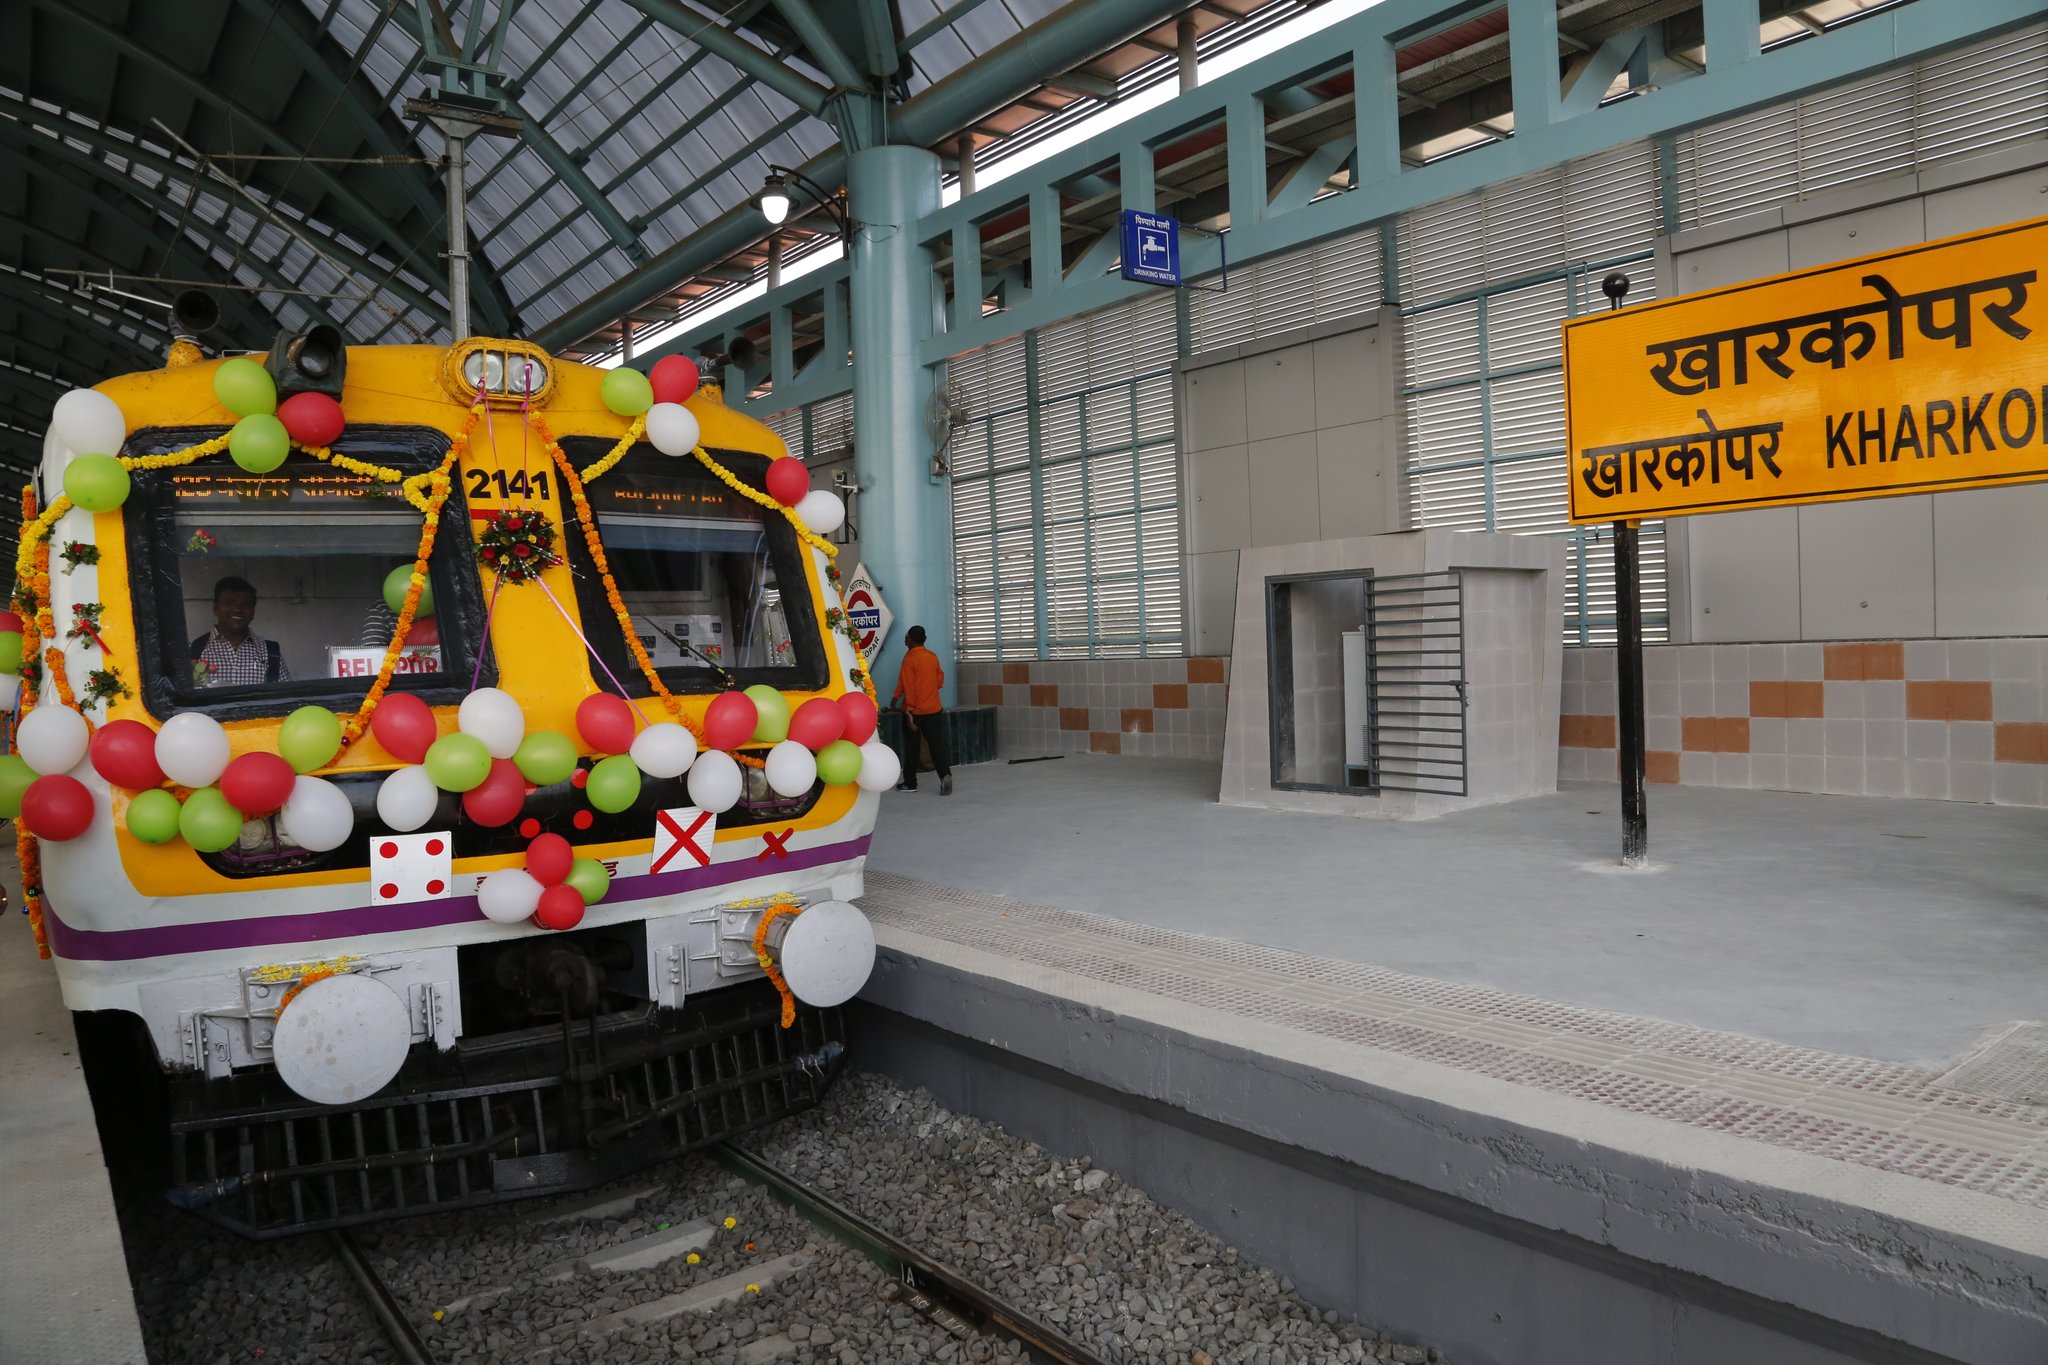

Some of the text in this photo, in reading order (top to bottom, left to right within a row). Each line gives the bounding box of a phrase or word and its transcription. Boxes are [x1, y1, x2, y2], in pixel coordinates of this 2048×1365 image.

[1134, 268, 1177, 281] DRINKING WATER
[1646, 269, 2037, 396] खारकोपर
[1582, 408, 1783, 498] खारकोपर
[1826, 384, 2048, 469] KHARKO
[466, 468, 550, 500] 2141
